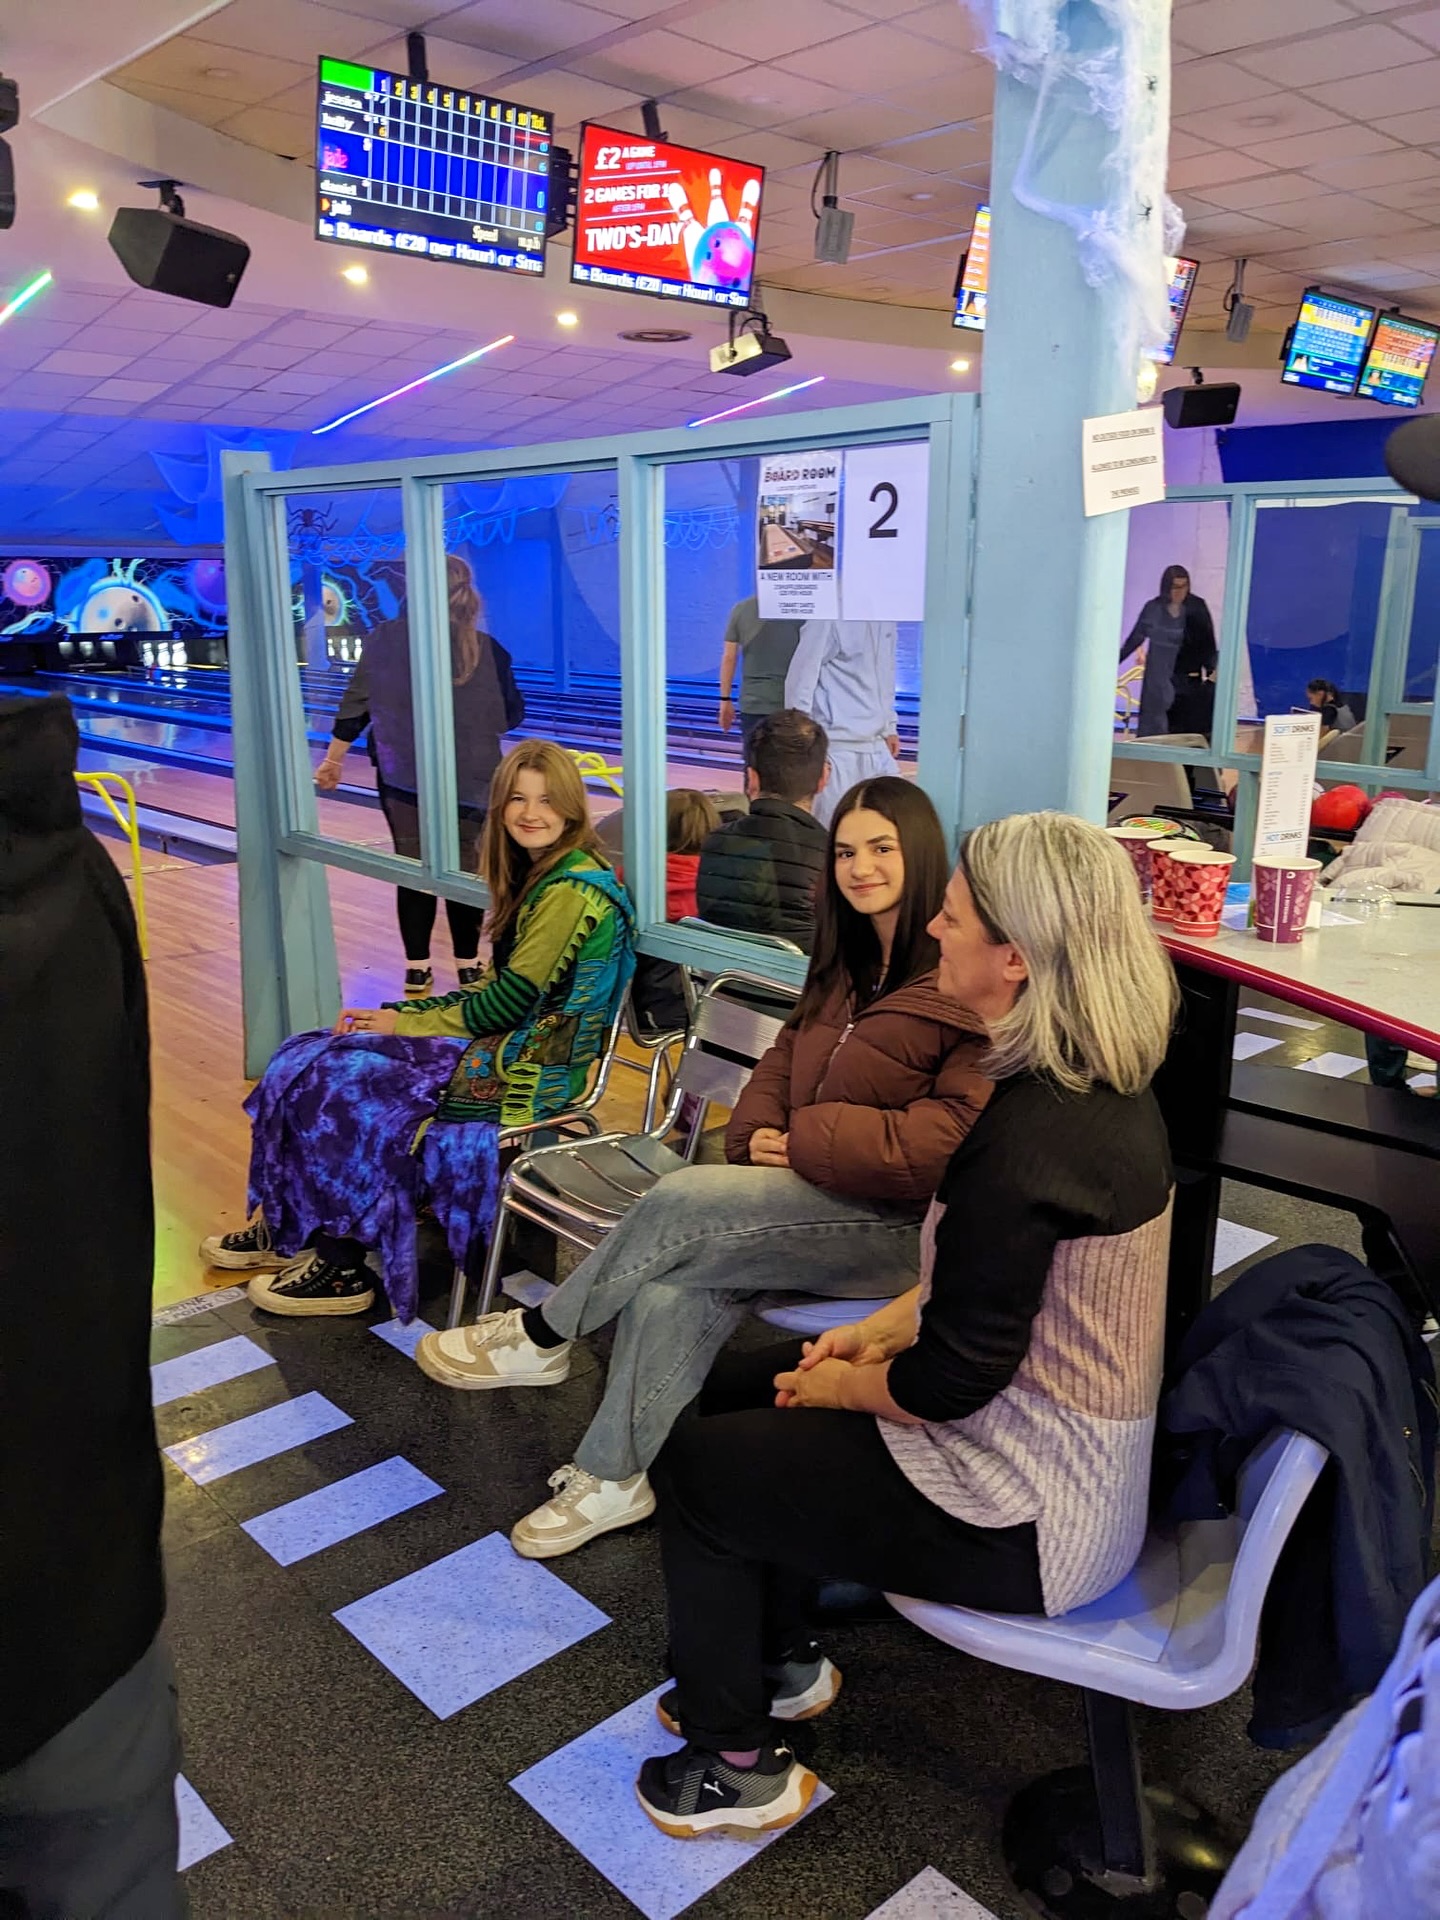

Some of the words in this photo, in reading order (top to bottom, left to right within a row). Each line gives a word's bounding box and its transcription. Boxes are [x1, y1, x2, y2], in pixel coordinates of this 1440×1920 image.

[381, 79, 387, 92] 1
[395, 82, 403, 96] 2
[410, 86, 418, 99] 3
[427, 91, 435, 104] 4
[443, 94, 450, 107] 5
[474, 101, 482, 115] 7
[506, 110, 513, 123] 9
[594, 147, 621, 170] £2
[584, 188, 594, 204] 2
[595, 185, 636, 203] GAMES
[636, 184, 660, 200] FOR
[336, 222, 395, 246] Boards
[498, 254, 514, 267] or
[585, 222, 684, 252] TWO'S-DAY
[590, 267, 635, 288] Boards
[764, 469, 800, 483] BOARD
[802, 466, 837, 480] ROOM
[869, 481, 899, 539] 2
[767, 572, 783, 581] NEW
[786, 572, 809, 581] ROOM
[812, 572, 833, 581] WITH
[1273, 725, 1290, 734] SOFT
[1291, 724, 1315, 733] DRINKS
[1266, 833, 1280, 841] HOT
[1280, 831, 1302, 841] DRINKS
